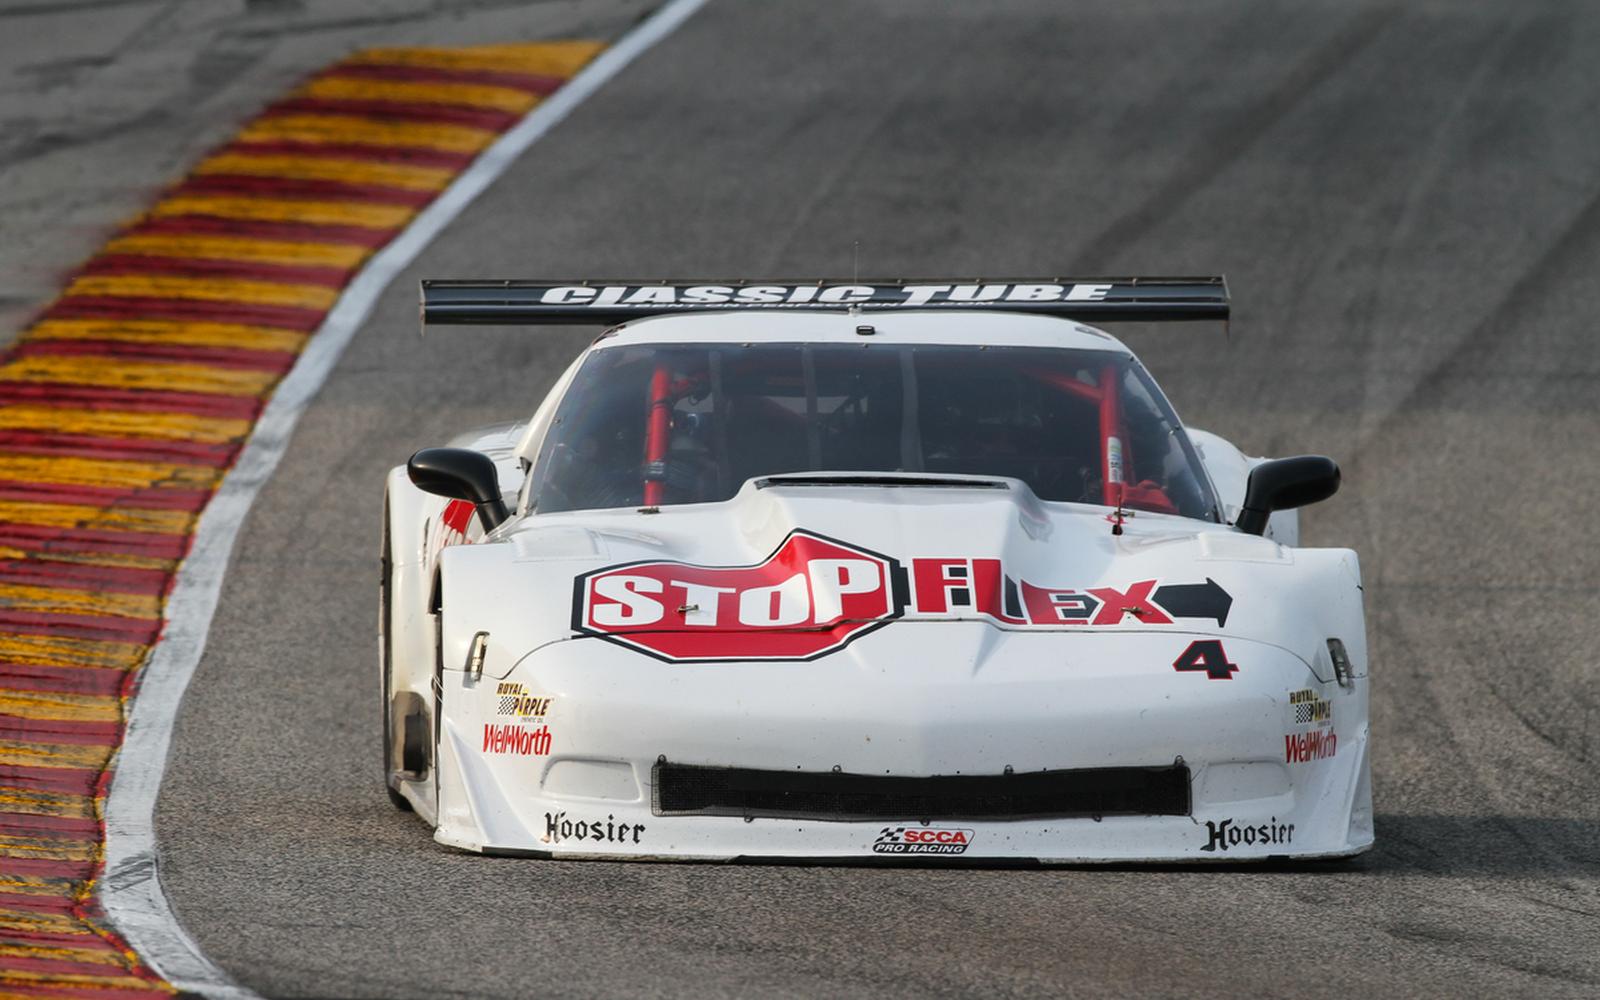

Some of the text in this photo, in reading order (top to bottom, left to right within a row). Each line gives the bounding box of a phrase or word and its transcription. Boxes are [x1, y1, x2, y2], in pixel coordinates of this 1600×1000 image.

[540, 284, 1113, 308] CLASSIC TUBE
[592, 557, 1175, 626] STOP FLEX
[1172, 640, 1240, 680] 4
[496, 682, 523, 695] ROYAL
[541, 811, 646, 844] Hoosier
[904, 831, 967, 844] SCCA
[1200, 816, 1295, 852] Hoosier
[875, 844, 965, 854] PRO RACING
